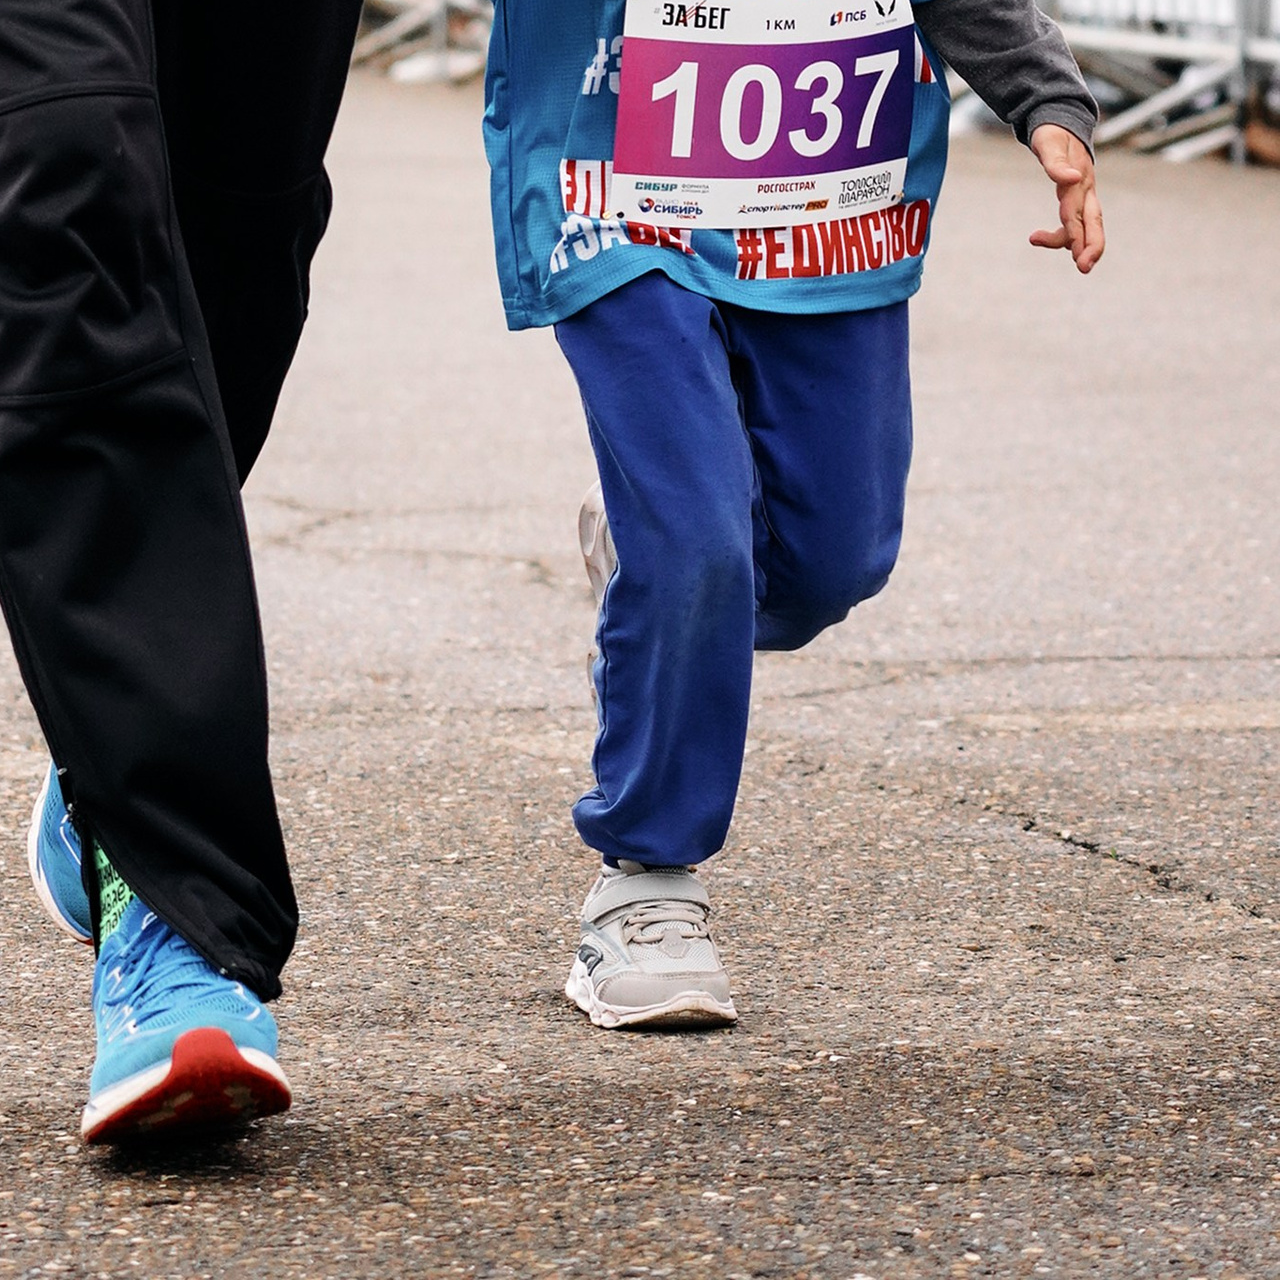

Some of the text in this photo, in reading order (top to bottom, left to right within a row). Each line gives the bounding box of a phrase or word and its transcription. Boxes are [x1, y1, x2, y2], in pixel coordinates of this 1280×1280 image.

[844, 9, 867, 22] ПСБ
[765, 19, 770, 30] 1
[651, 49, 900, 162] 1037
[635, 181, 678, 192] СИБУР
[757, 181, 816, 194] РОСГОССТРАХ
[840, 170, 891, 192] ТОМСКИЙ
[838, 184, 890, 205] МАРАФОН
[653, 204, 703, 215] СИБИРЬ
